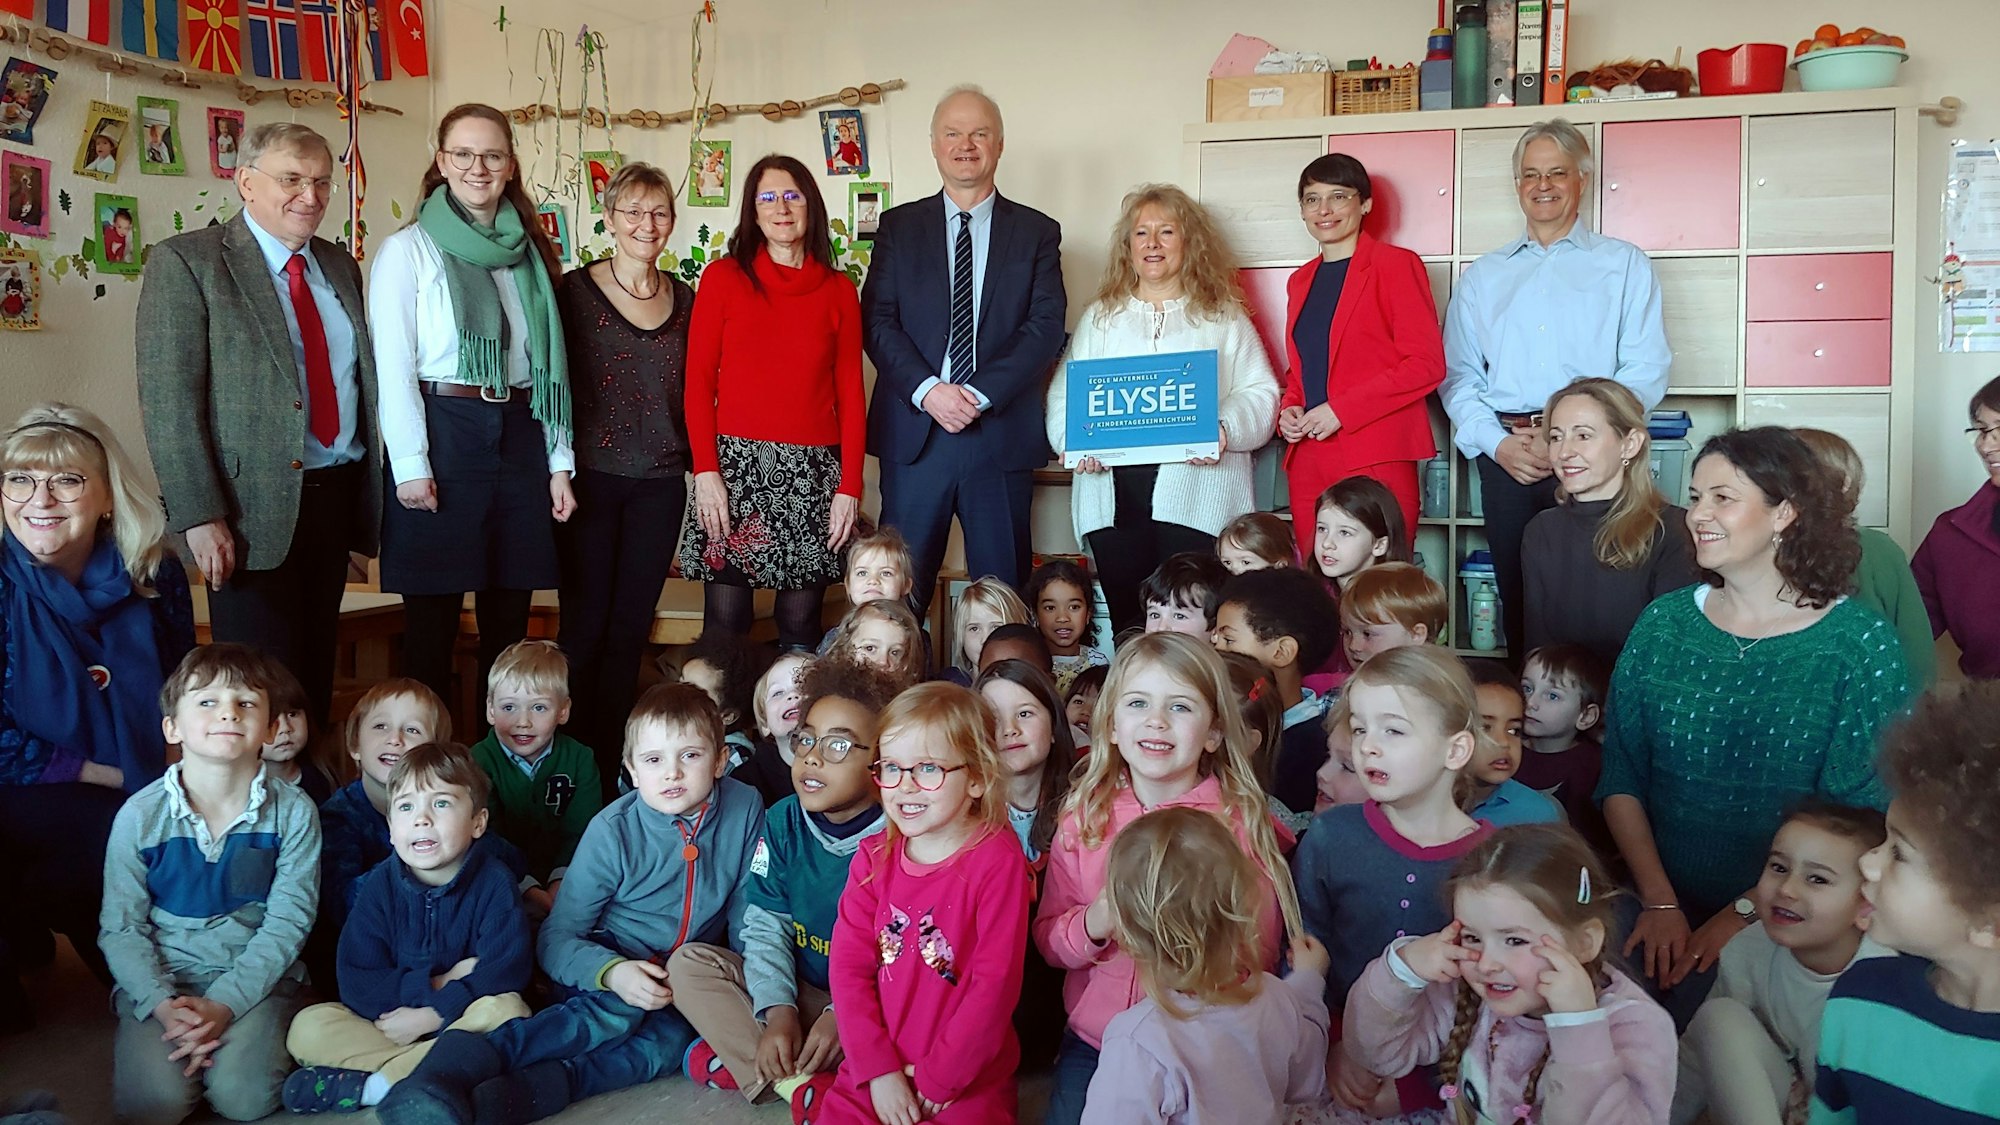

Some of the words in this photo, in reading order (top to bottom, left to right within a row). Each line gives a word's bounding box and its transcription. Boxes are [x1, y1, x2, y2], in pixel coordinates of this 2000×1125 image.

[1113, 374, 1158, 383] MATERNELLE
[1088, 379, 1197, 417] ÉLYSÉE
[1097, 415, 1197, 428] KINDERTAGESEINRICHTUNG
